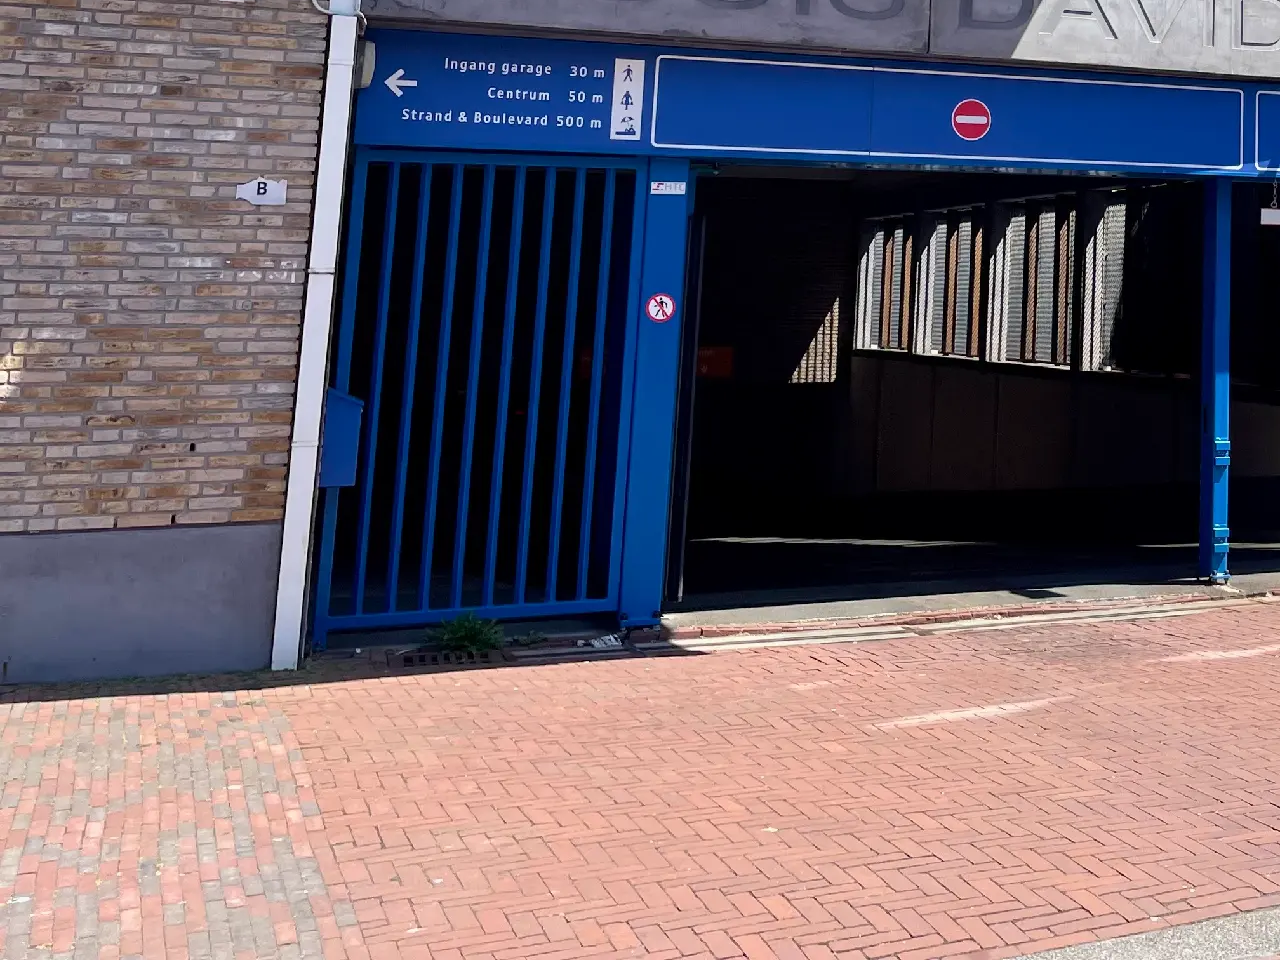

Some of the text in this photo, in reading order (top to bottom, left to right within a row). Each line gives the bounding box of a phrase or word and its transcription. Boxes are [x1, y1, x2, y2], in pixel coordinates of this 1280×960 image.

[444, 57, 605, 78] Ingang garage 30 m
[487, 87, 603, 103] Centrum 50 m
[402, 108, 602, 129] Strand & Boulevard 500 m
[257, 181, 267, 196] B
